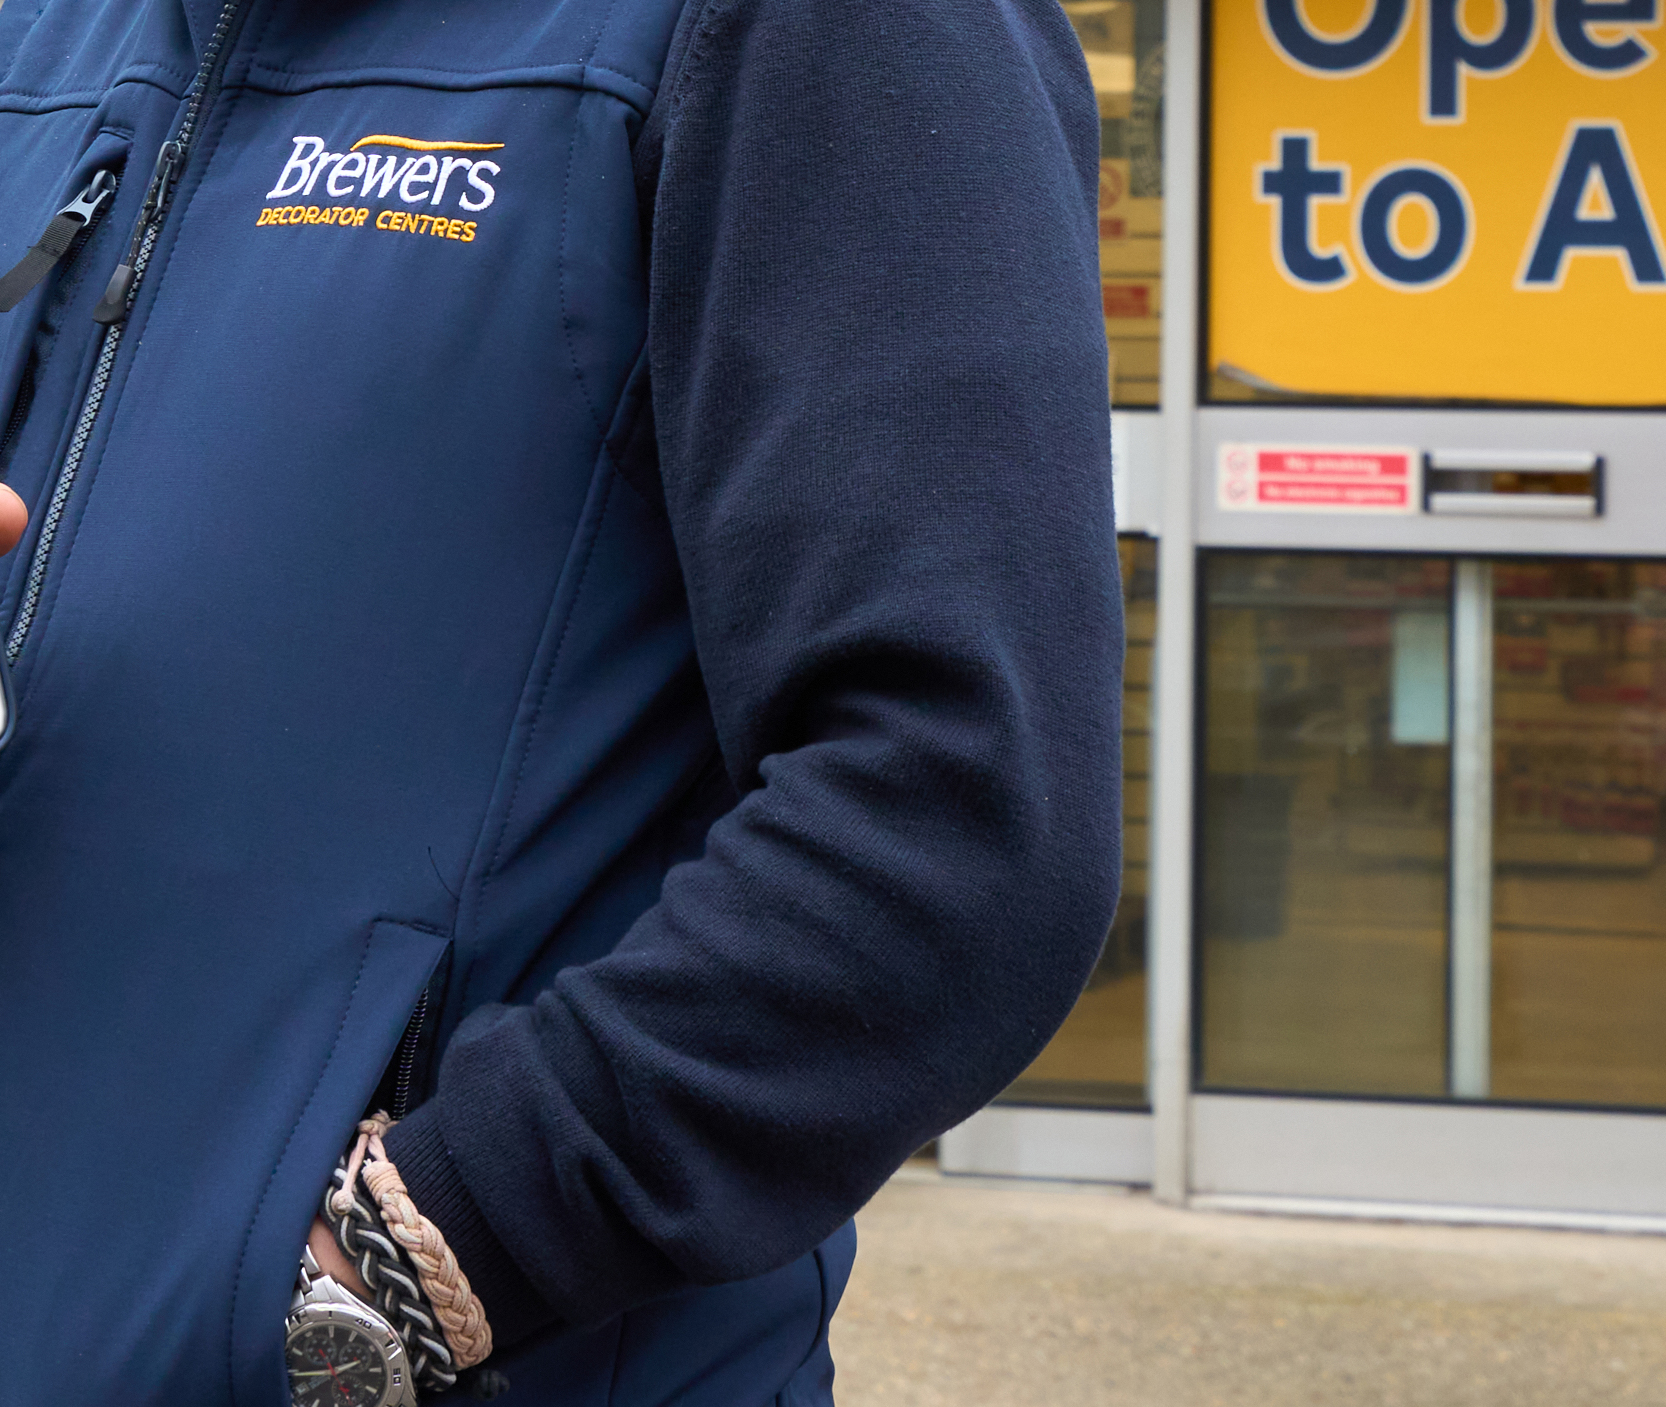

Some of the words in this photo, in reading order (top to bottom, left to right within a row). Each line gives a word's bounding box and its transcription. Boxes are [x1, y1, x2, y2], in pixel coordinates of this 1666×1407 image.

[265, 135, 501, 212] Brewers
[1258, 133, 1470, 288] to
[255, 205, 370, 228] DECORATOR
[375, 209, 478, 243] CENTRES
